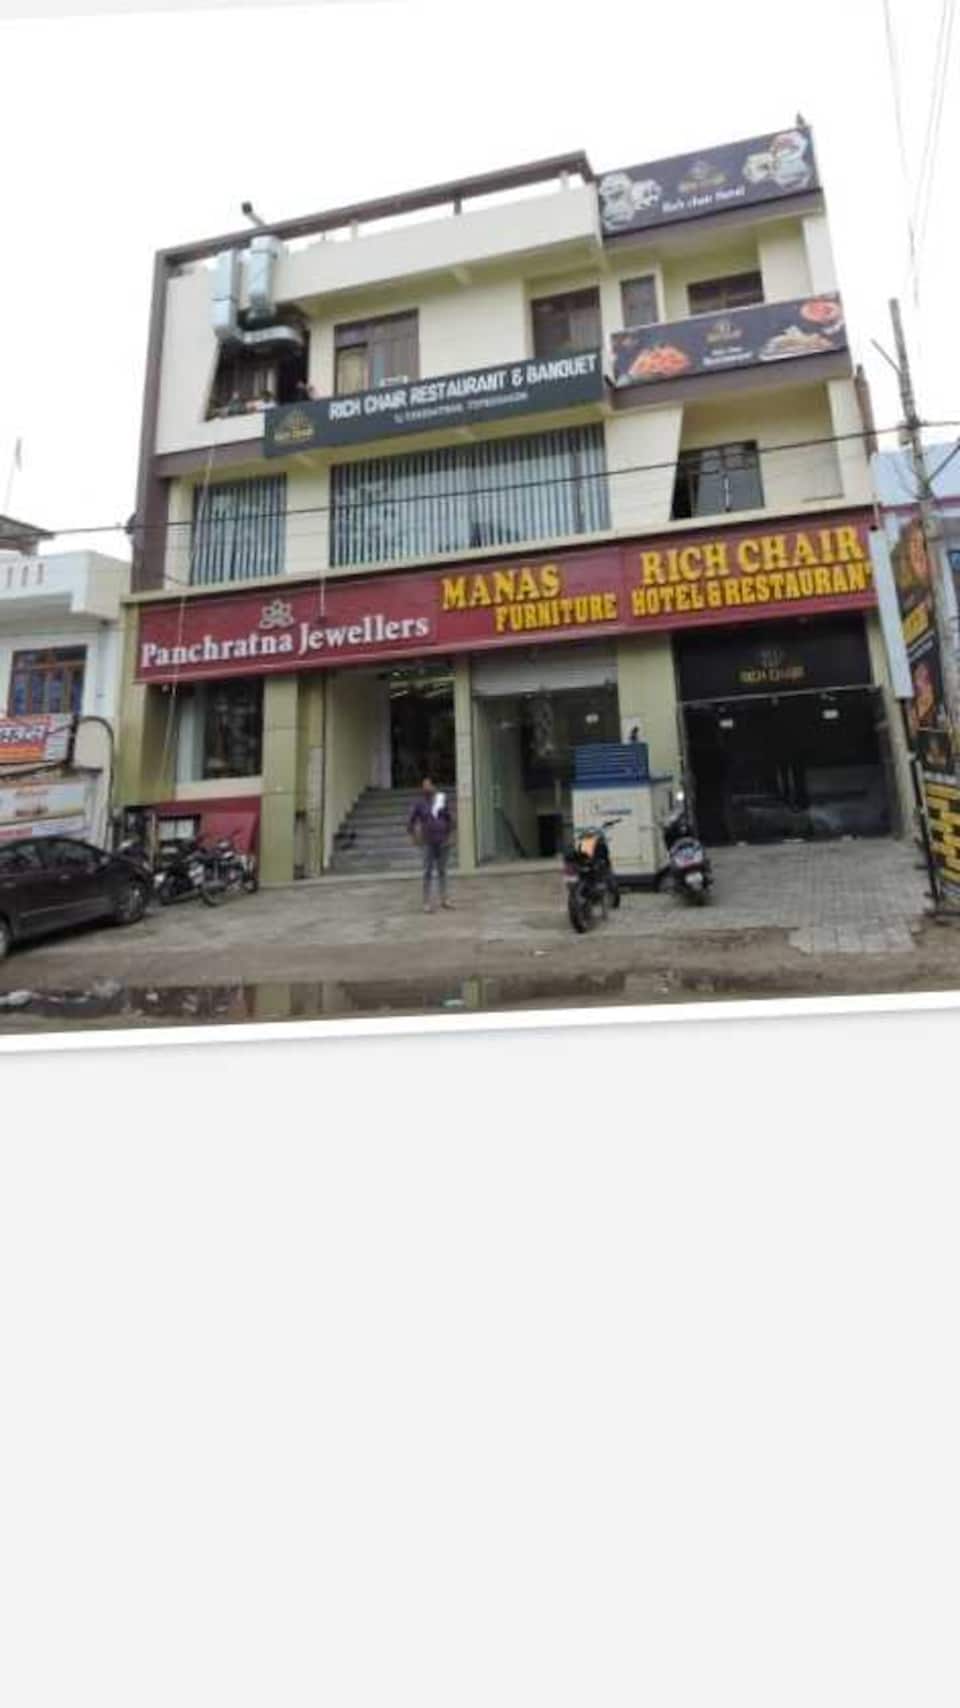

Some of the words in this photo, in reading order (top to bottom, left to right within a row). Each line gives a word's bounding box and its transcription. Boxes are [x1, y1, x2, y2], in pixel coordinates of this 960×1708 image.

[329, 398, 361, 421] RICH
[364, 388, 407, 415] CHAIR
[409, 371, 508, 406] RESTAURANT
[511, 367, 524, 387] &
[526, 353, 598, 384] BANQUET
[639, 541, 730, 585] RICH
[738, 525, 865, 575] CHAIR
[441, 563, 561, 611] MANAS
[495, 591, 618, 633] FURNITURE
[631, 583, 703, 617] HOTEL
[140, 631, 294, 669] Panchratna
[298, 613, 430, 655] Jewellers
